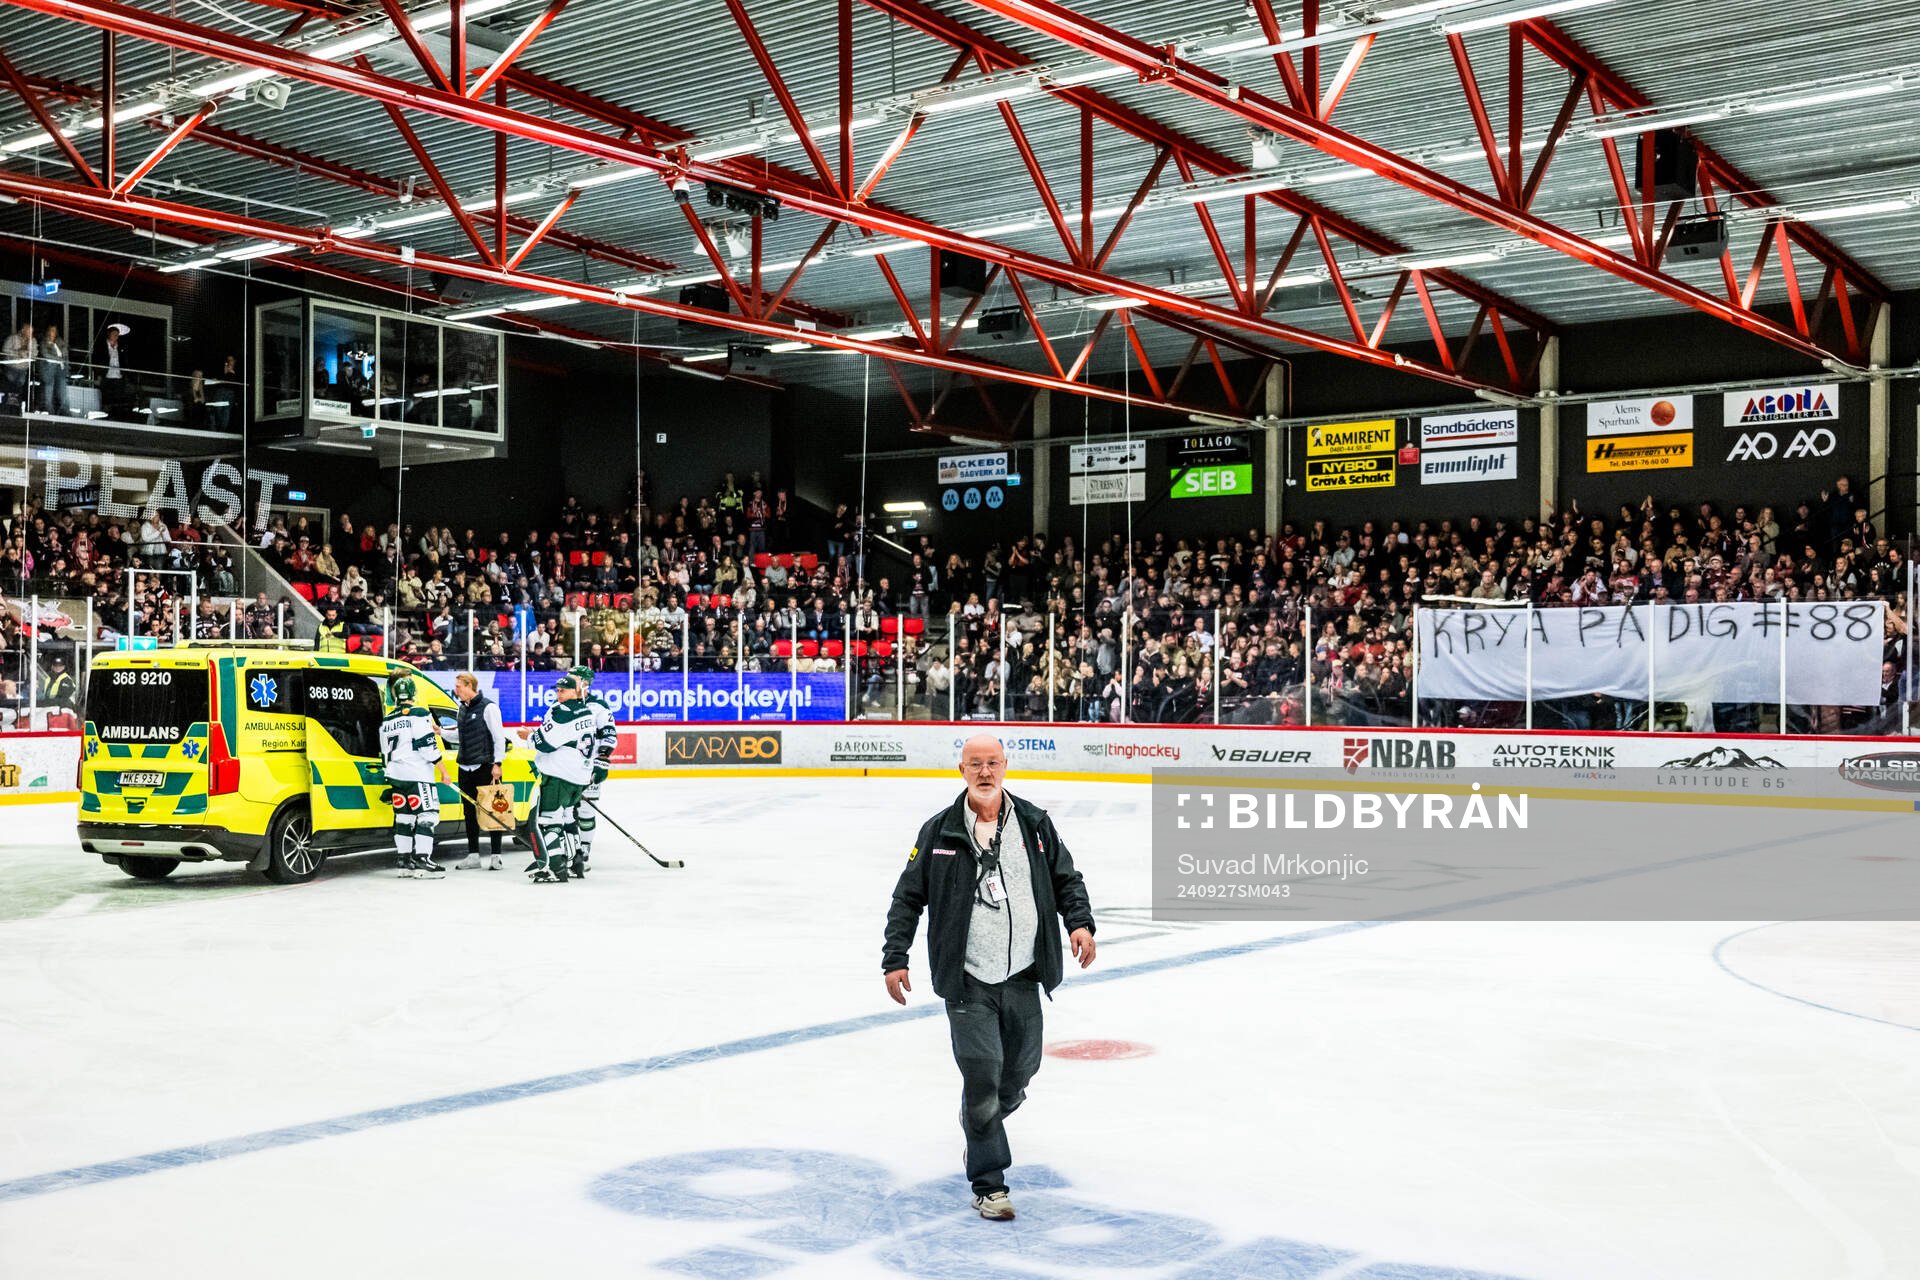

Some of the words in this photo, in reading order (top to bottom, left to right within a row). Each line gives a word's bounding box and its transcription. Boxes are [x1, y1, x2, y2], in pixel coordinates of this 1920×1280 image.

[1598, 416, 1641, 429] Sparbank
[1183, 435, 1232, 449] TOLAGO
[1325, 429, 1391, 447] RAMIRENT
[1663, 444, 1688, 455] VVS
[1321, 459, 1378, 474] NYBRO
[1185, 470, 1236, 492] SEB
[1349, 472, 1391, 485] Schakt
[1433, 611, 1549, 658] KRYA
[1668, 604, 1738, 643] DIG
[113, 671, 136, 686] 368
[141, 671, 172, 686] 9210
[309, 686, 329, 699] 368
[332, 687, 354, 701] 9210
[102, 726, 180, 740] AMBULANS
[262, 740, 288, 749] Region
[387, 735, 399, 762] 7
[668, 736, 778, 759] KLARABO
[834, 741, 903, 753] BARONESS
[1018, 738, 1056, 751] STENA
[1083, 744, 1103, 752] sport
[1108, 743, 1180, 760] tinghockey
[1493, 744, 1615, 758] AUTOTEKNIK
[1371, 738, 1456, 769] NBAB
[1844, 759, 1920, 772] KOLSB
[123, 772, 138, 785] MKE
[1657, 775, 1750, 788] LATITUDE
